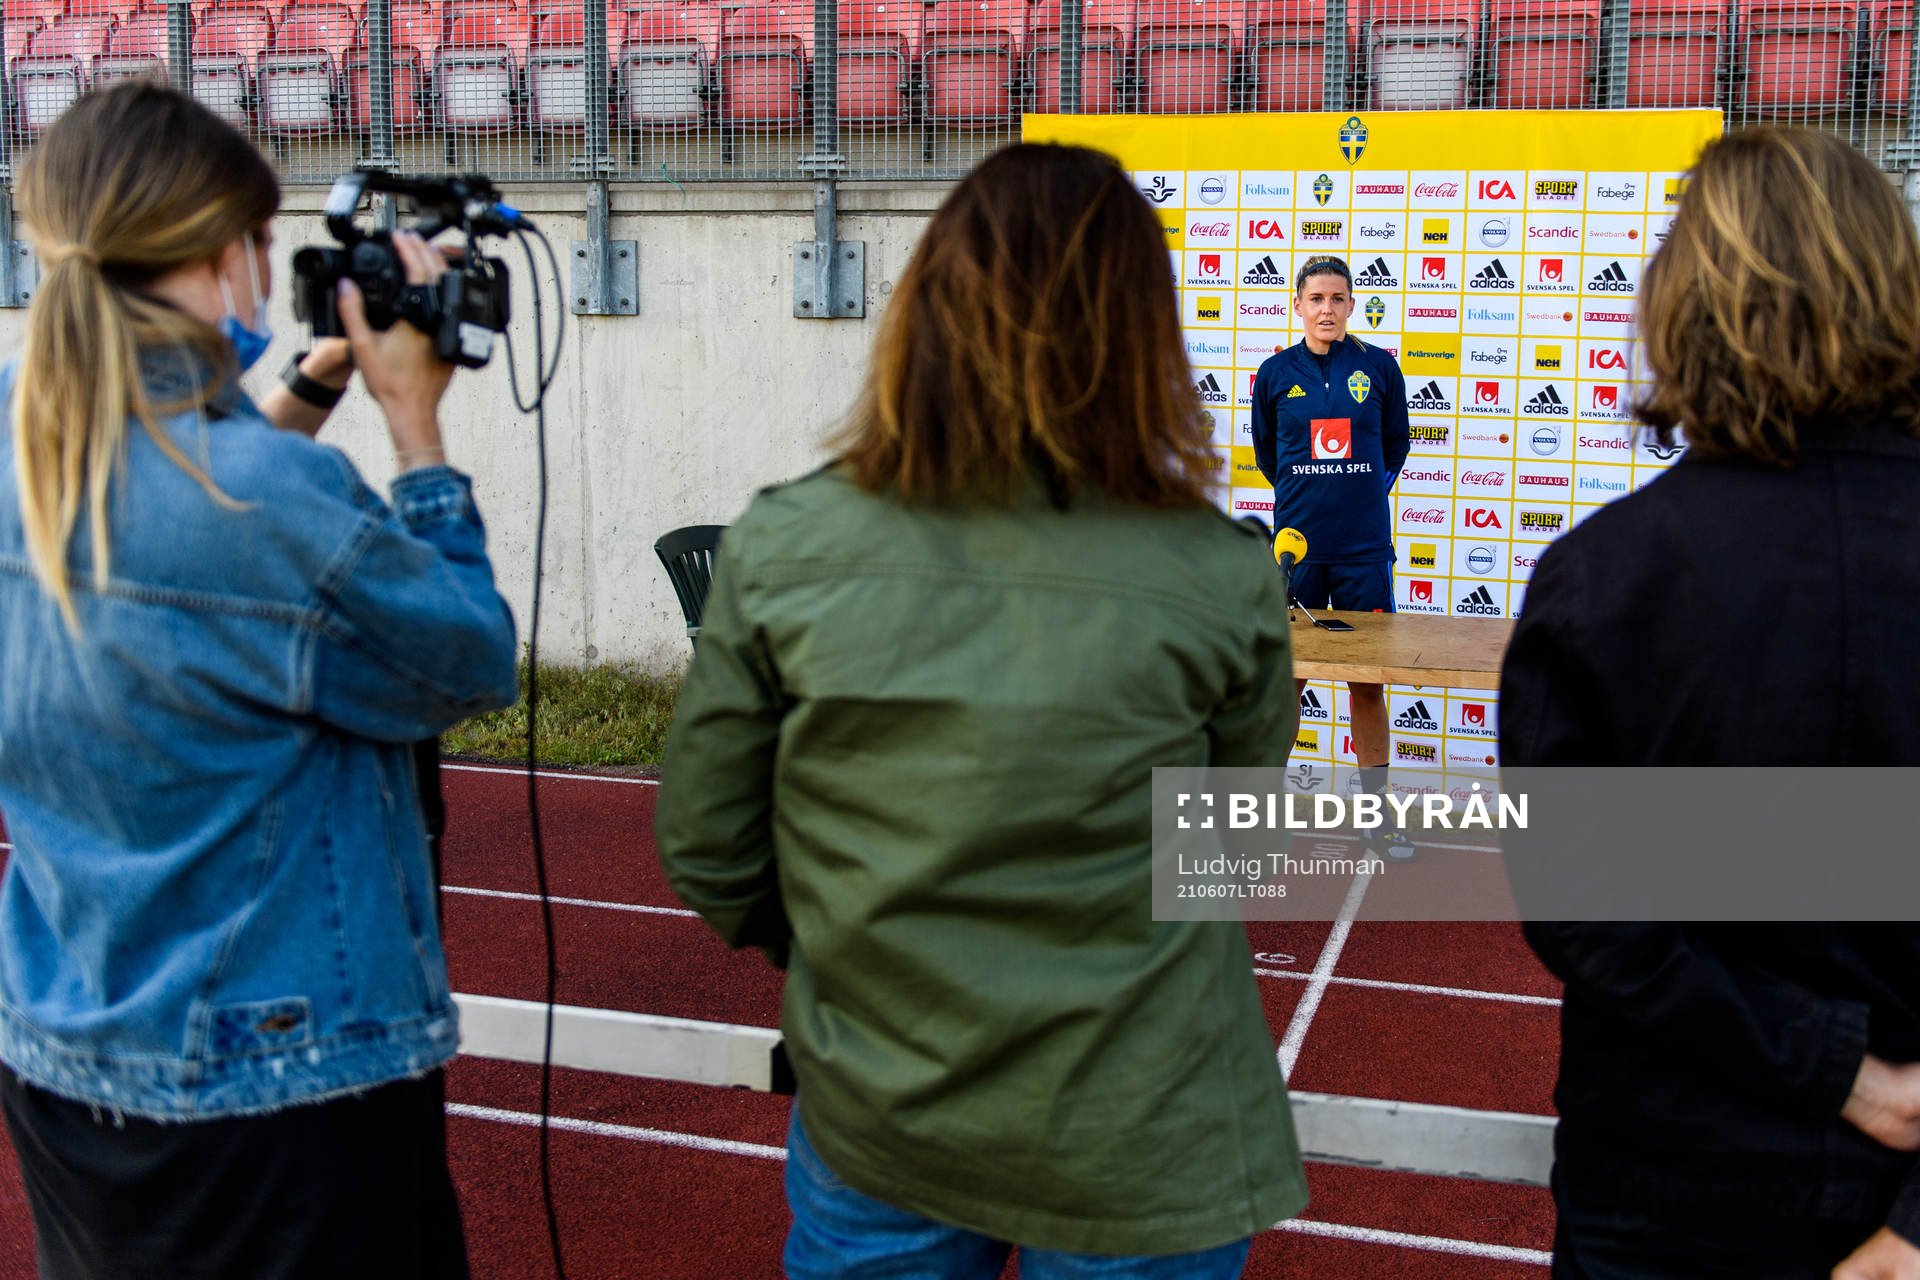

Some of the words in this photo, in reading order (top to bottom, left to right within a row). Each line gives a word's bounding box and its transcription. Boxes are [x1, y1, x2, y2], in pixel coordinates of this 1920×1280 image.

[1152, 176, 1167, 188] SJ
[1535, 180, 1578, 196] SPORT
[1245, 185, 1289, 195] Folksam
[1357, 186, 1403, 194] BAUHAUS
[1479, 181, 1516, 199] ICA
[1598, 186, 1636, 200] Fabege
[1249, 220, 1284, 239] ICA
[1301, 221, 1342, 236] SPORT
[1360, 226, 1396, 238] Fabege
[1528, 226, 1579, 238] Scandic
[1589, 230, 1626, 238] Swedbank
[1242, 274, 1286, 286] adidas
[1354, 274, 1398, 288] adidas
[1409, 282, 1440, 290] SVENSKA
[1441, 282, 1458, 290] SPEL
[1470, 276, 1516, 290] adidas
[1588, 280, 1634, 292] adidas
[1526, 283, 1557, 292] SVENSKA
[1558, 284, 1576, 292] SPEL
[1240, 304, 1287, 316] Scandic
[1409, 308, 1456, 317] BAUHAUS
[1468, 309, 1515, 321] Folksam
[1187, 342, 1229, 354] Folksam
[1240, 345, 1273, 353] Swedbank
[1470, 350, 1508, 364] Fabege
[1589, 349, 1627, 369] ICA
[1408, 398, 1452, 410] adidas
[1462, 405, 1493, 413] SVENSKA
[1494, 406, 1512, 415] SPEL
[1522, 402, 1570, 416] adidas
[1580, 410, 1611, 419] SVENSKA
[1408, 425, 1449, 440] SPORT
[1579, 436, 1629, 449] Scandic
[1291, 464, 1344, 476] SVENSKA
[1345, 463, 1373, 474] SPEL
[1402, 469, 1451, 482] Scandic
[1519, 475, 1568, 486] BAUHAUS
[1579, 477, 1626, 491] Folksam
[1235, 501, 1275, 511] BAUHAU
[1465, 508, 1502, 528] ICA
[1520, 511, 1564, 527] SPORT
[1521, 525, 1562, 533] BLADET
[1397, 603, 1427, 611] SVENSKA
[1428, 605, 1444, 613] SPEL
[1456, 602, 1500, 616] adidas
[1300, 705, 1328, 719] idas
[1394, 716, 1438, 730] adidas
[1448, 727, 1479, 736] SVENSKA
[1480, 728, 1497, 737] SPEL
[1396, 741, 1436, 757] SPORT
[1397, 754, 1435, 762] BLADET
[1449, 754, 1483, 763] Swedbank
[1299, 763, 1313, 776] SJ
